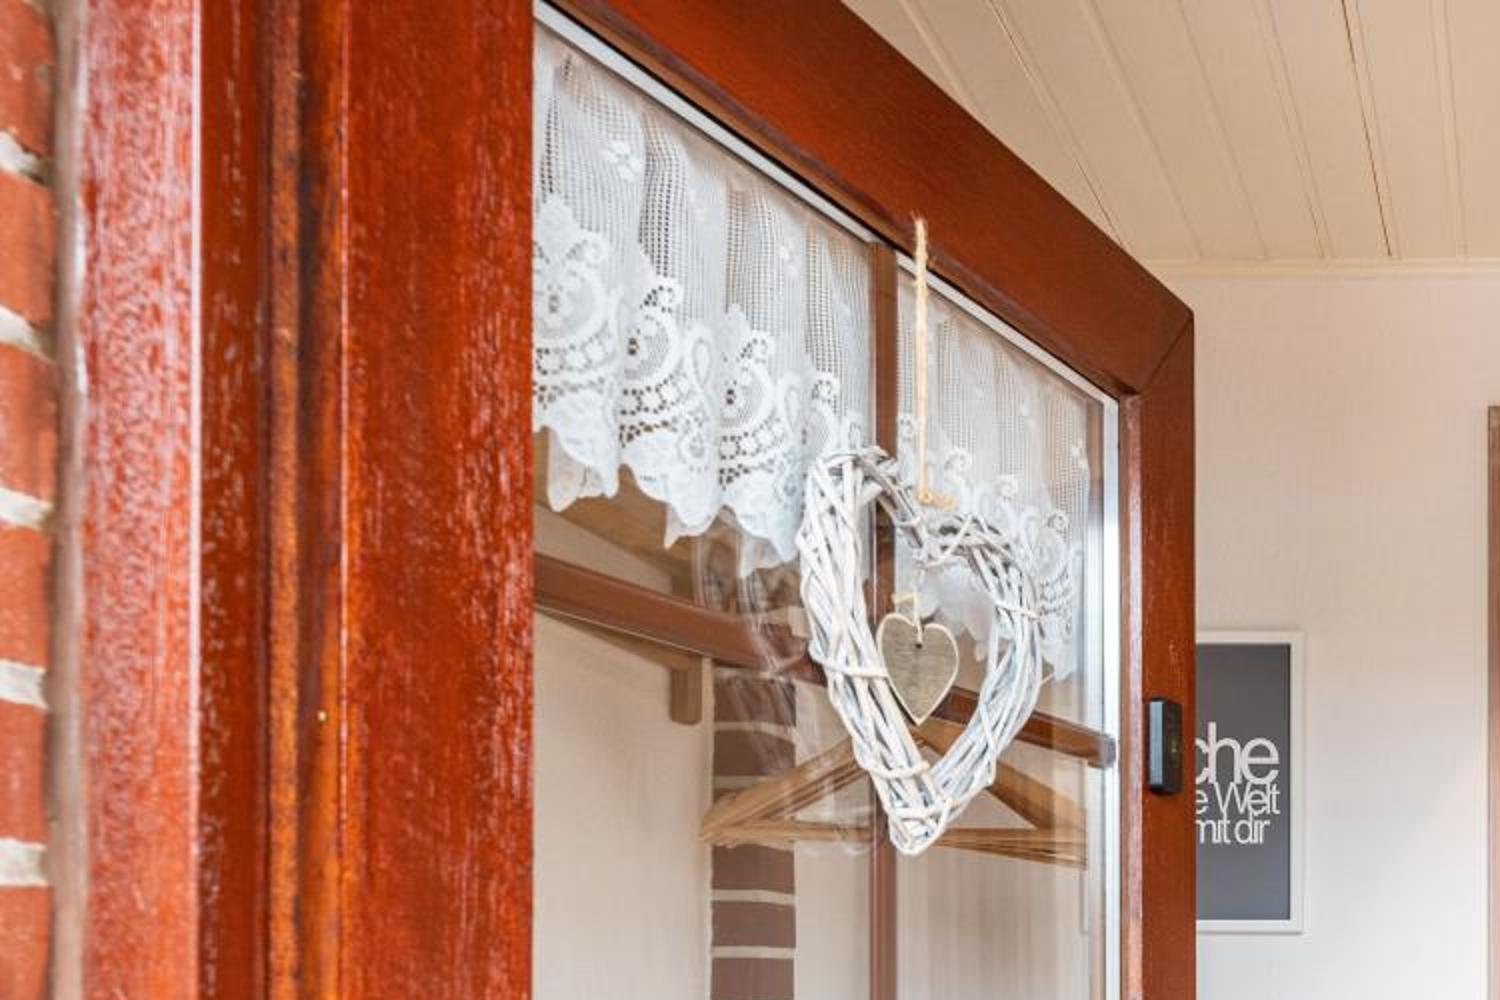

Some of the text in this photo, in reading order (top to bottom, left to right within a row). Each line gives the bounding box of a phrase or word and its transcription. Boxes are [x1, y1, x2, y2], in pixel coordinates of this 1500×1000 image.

[1213, 781, 1280, 815] Welt
[1196, 810, 1270, 844] mit dir
